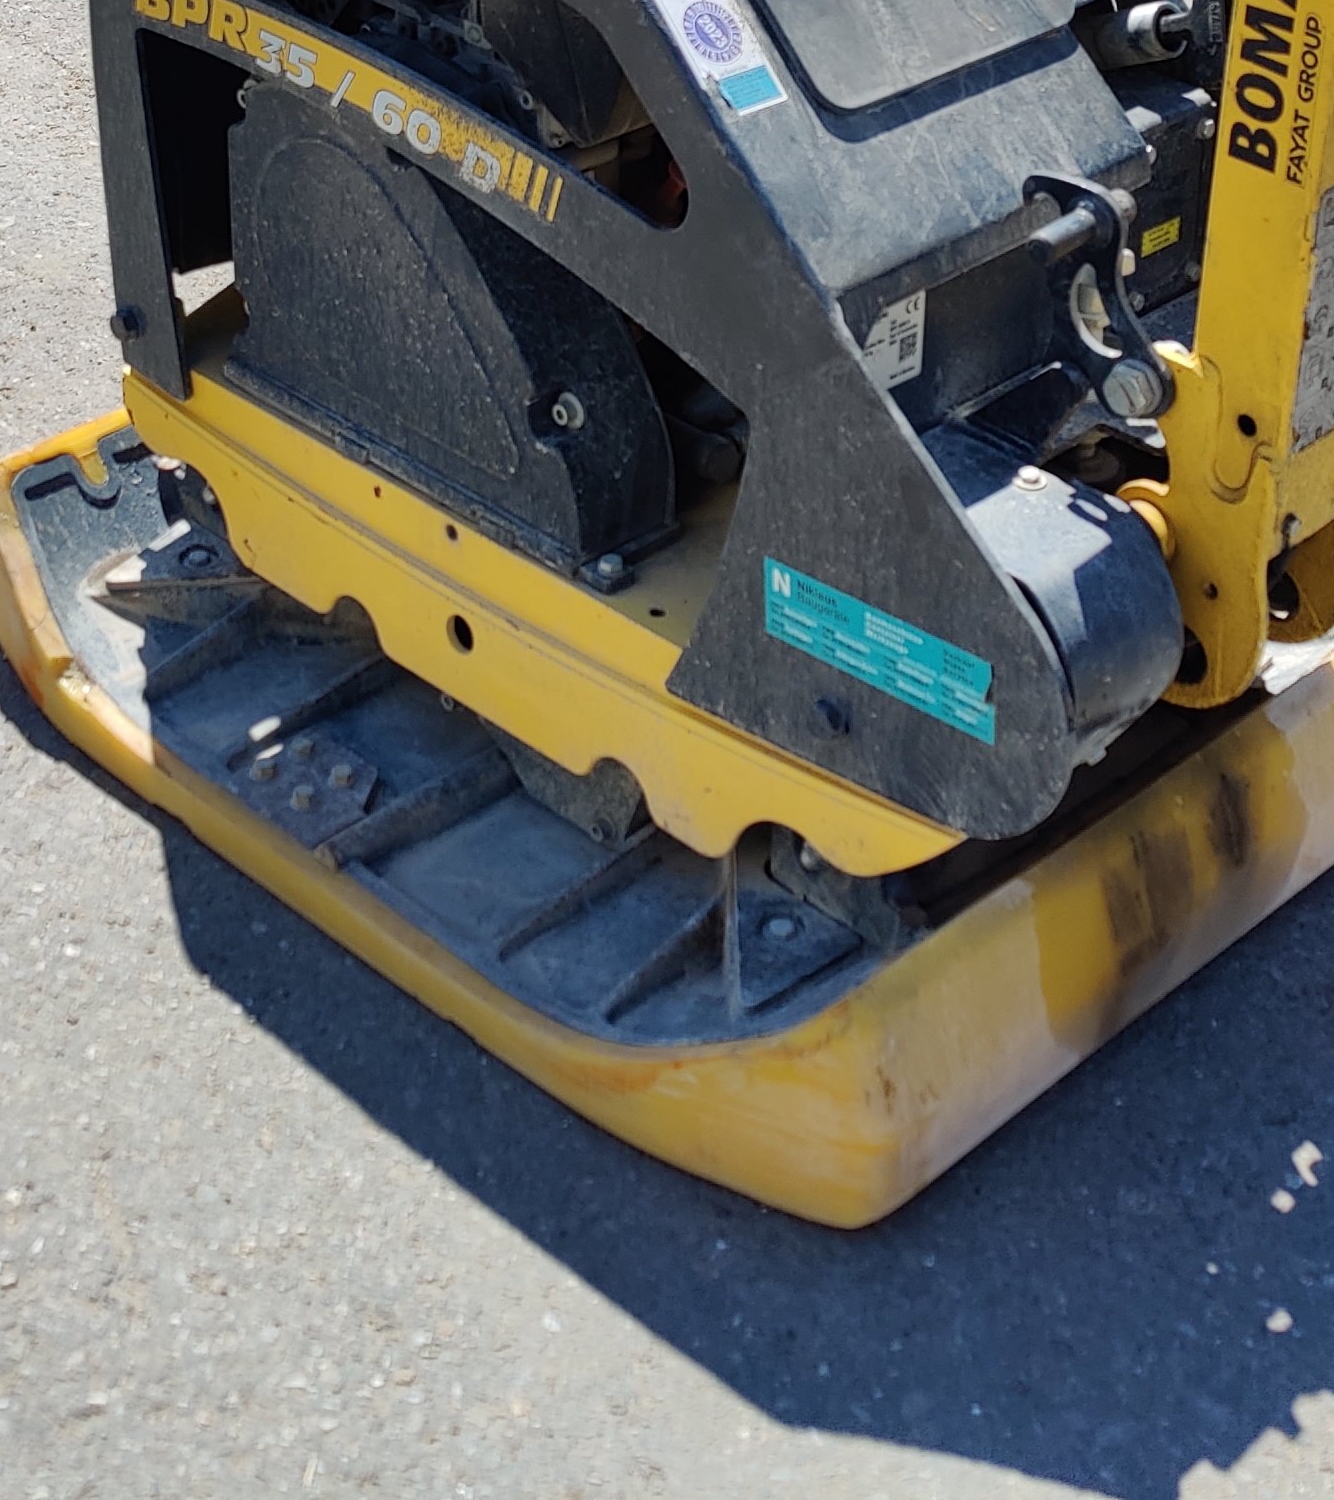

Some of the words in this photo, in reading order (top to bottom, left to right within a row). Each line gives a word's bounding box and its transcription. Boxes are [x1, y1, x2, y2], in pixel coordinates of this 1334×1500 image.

[1297, 15, 1323, 104] GROUP
[371, 89, 443, 156] 60
[1287, 109, 1312, 186] FAYAT
[771, 567, 792, 599] N
